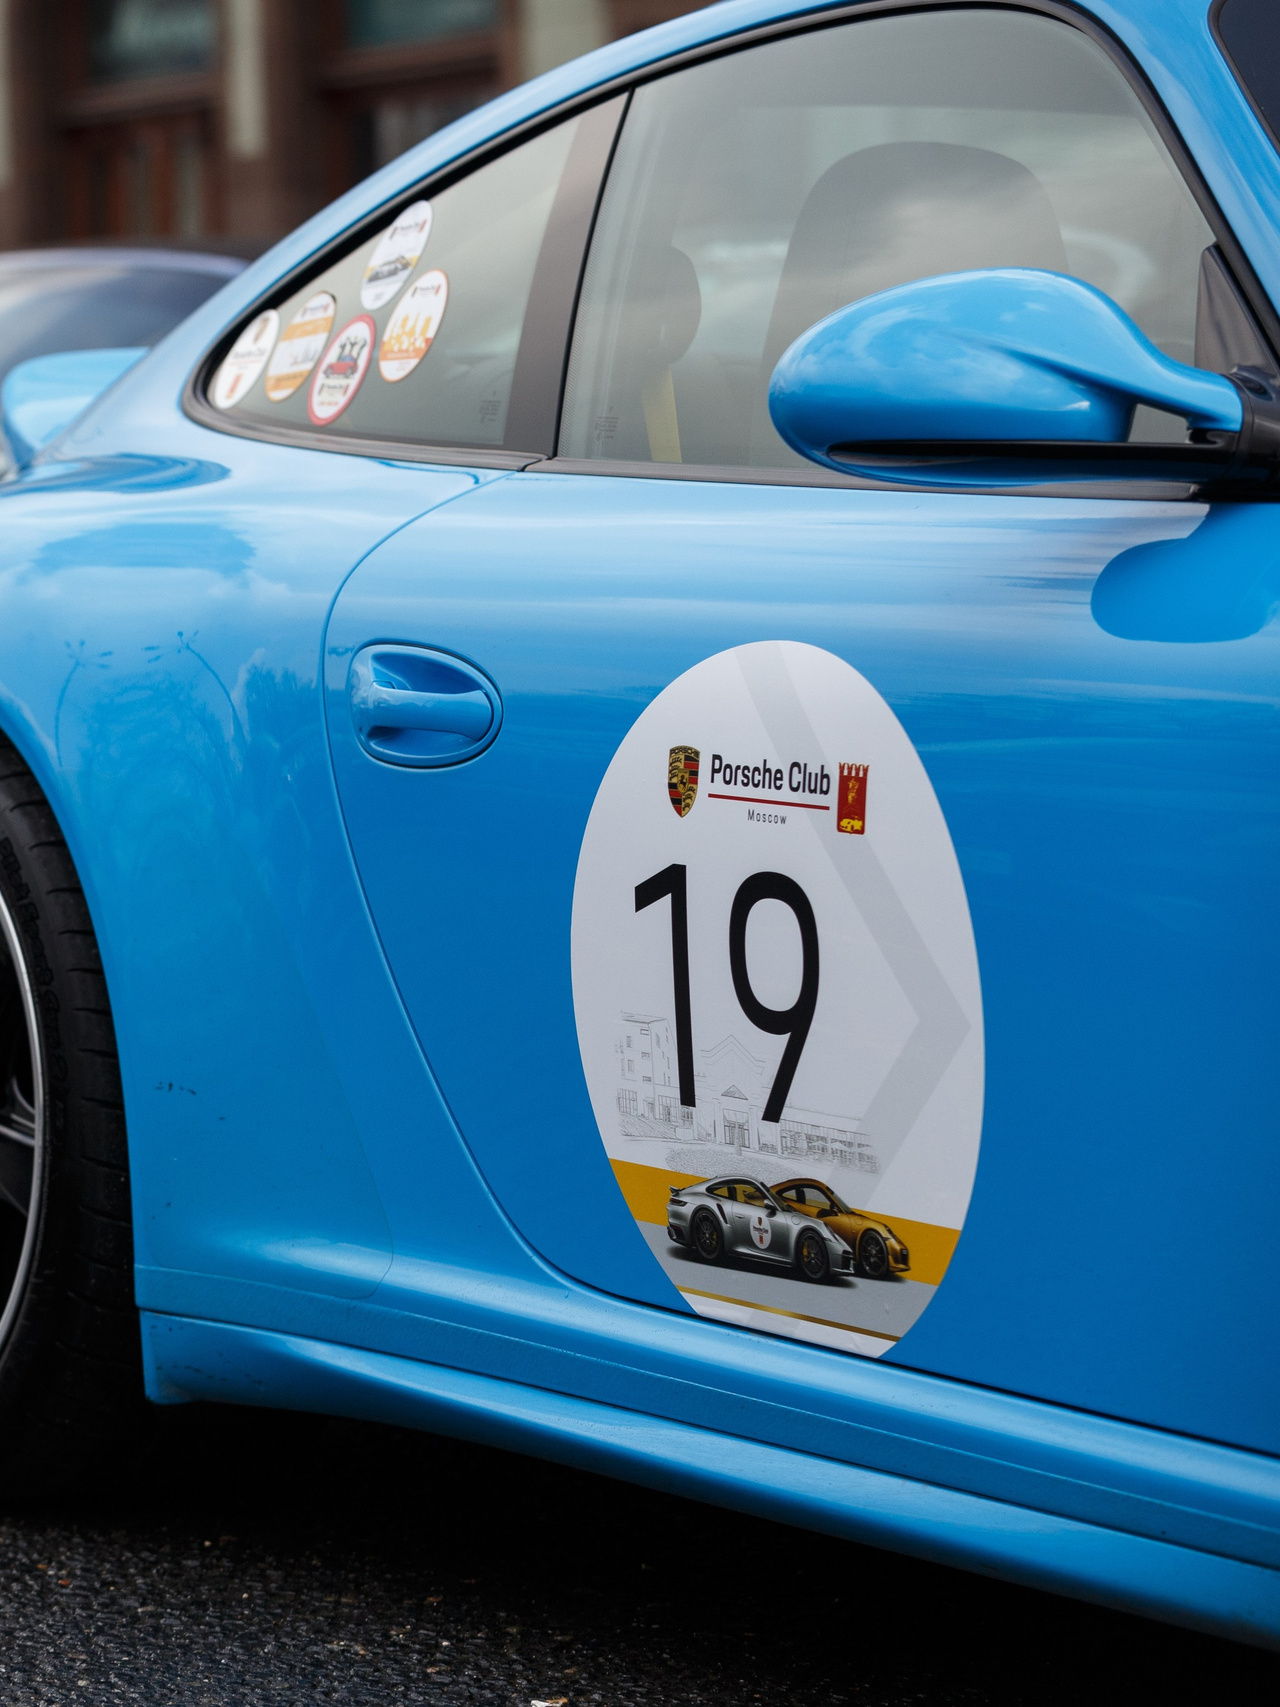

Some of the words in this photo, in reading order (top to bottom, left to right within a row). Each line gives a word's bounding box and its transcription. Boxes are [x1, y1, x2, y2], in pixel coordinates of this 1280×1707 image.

[710, 753, 784, 791] Porsche
[788, 761, 831, 796] Club
[747, 808, 787, 825] Moscow
[634, 863, 820, 1124] 19
